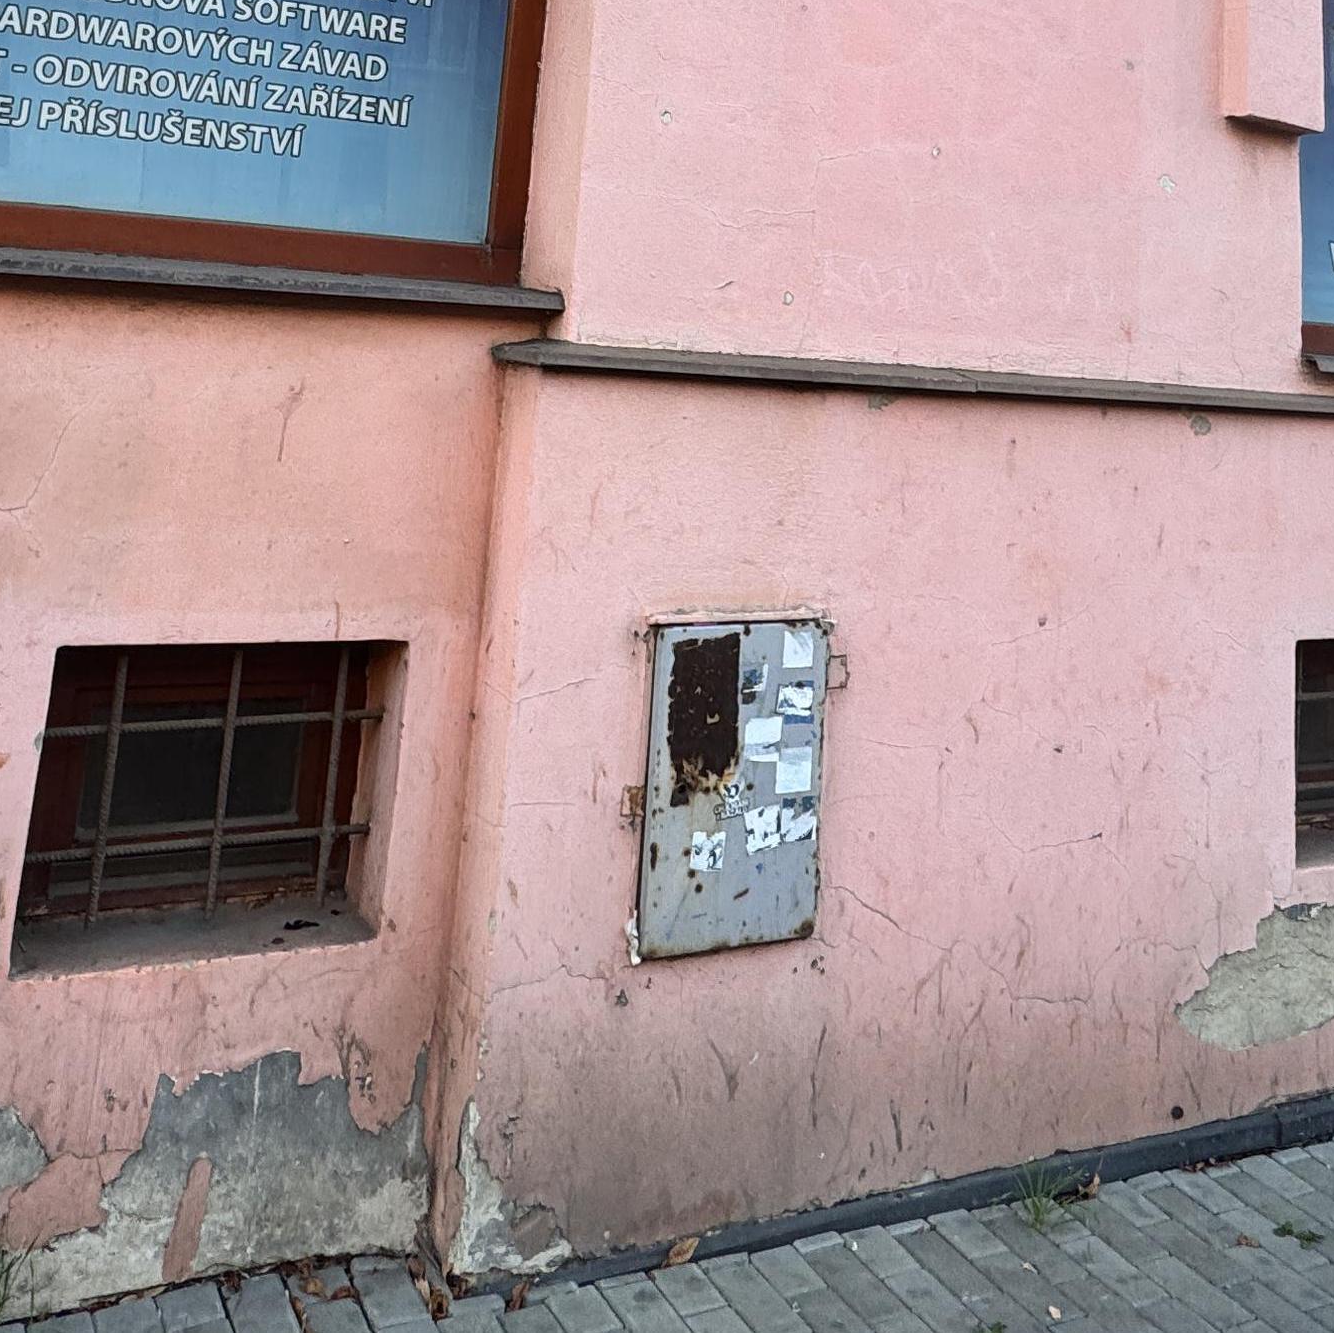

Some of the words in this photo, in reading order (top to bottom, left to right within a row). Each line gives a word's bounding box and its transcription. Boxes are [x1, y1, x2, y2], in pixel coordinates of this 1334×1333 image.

[35, 54, 258, 112] ODVIROVÁNÍ
[265, 77, 414, 128] ZAŘÍZENÍ
[280, 37, 388, 83] ZÁVAD
[39, 93, 305, 158] PŘÍSLUŠENSTVÍ
